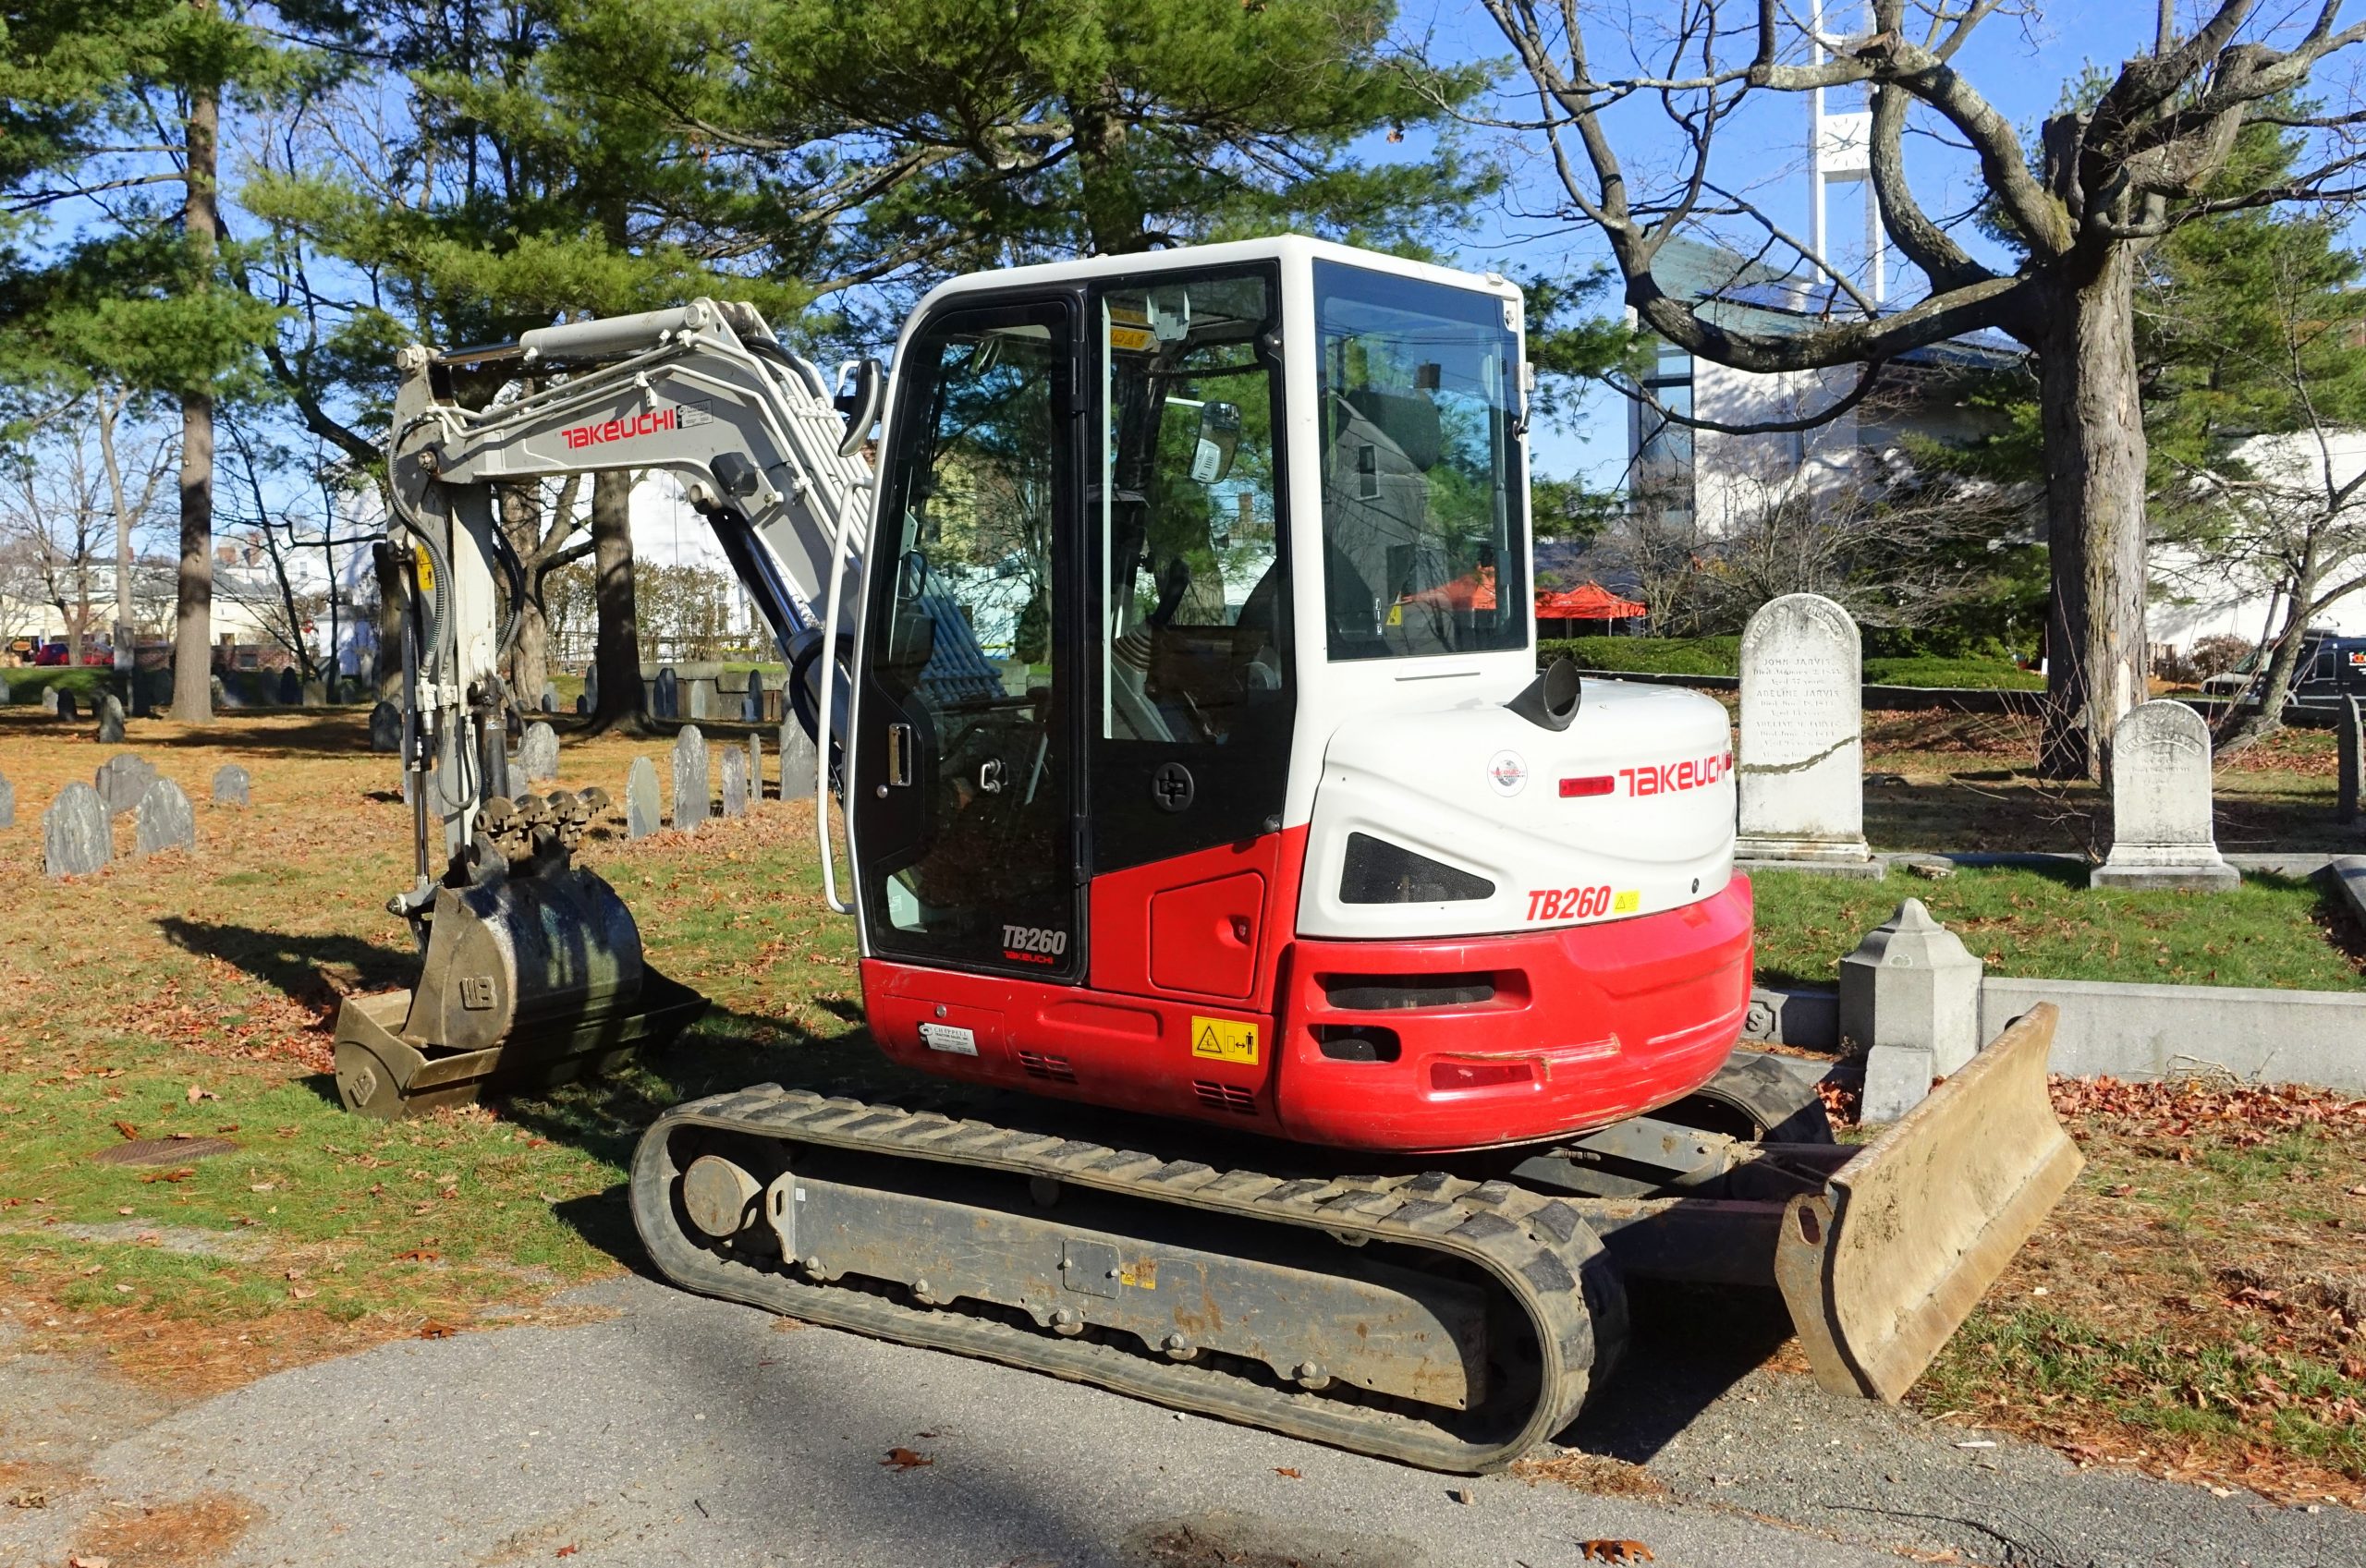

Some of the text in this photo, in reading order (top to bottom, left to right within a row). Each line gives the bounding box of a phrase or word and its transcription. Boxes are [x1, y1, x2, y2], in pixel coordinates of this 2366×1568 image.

[562, 408, 675, 449] TAKEUCHI
[1763, 658, 1788, 666] JOHN
[1619, 752, 1726, 797] TAKEUCHI
[1527, 886, 1612, 921] TB260
[1003, 925, 1067, 954] TB260
[1003, 951, 1054, 965] TAKEUCHI
